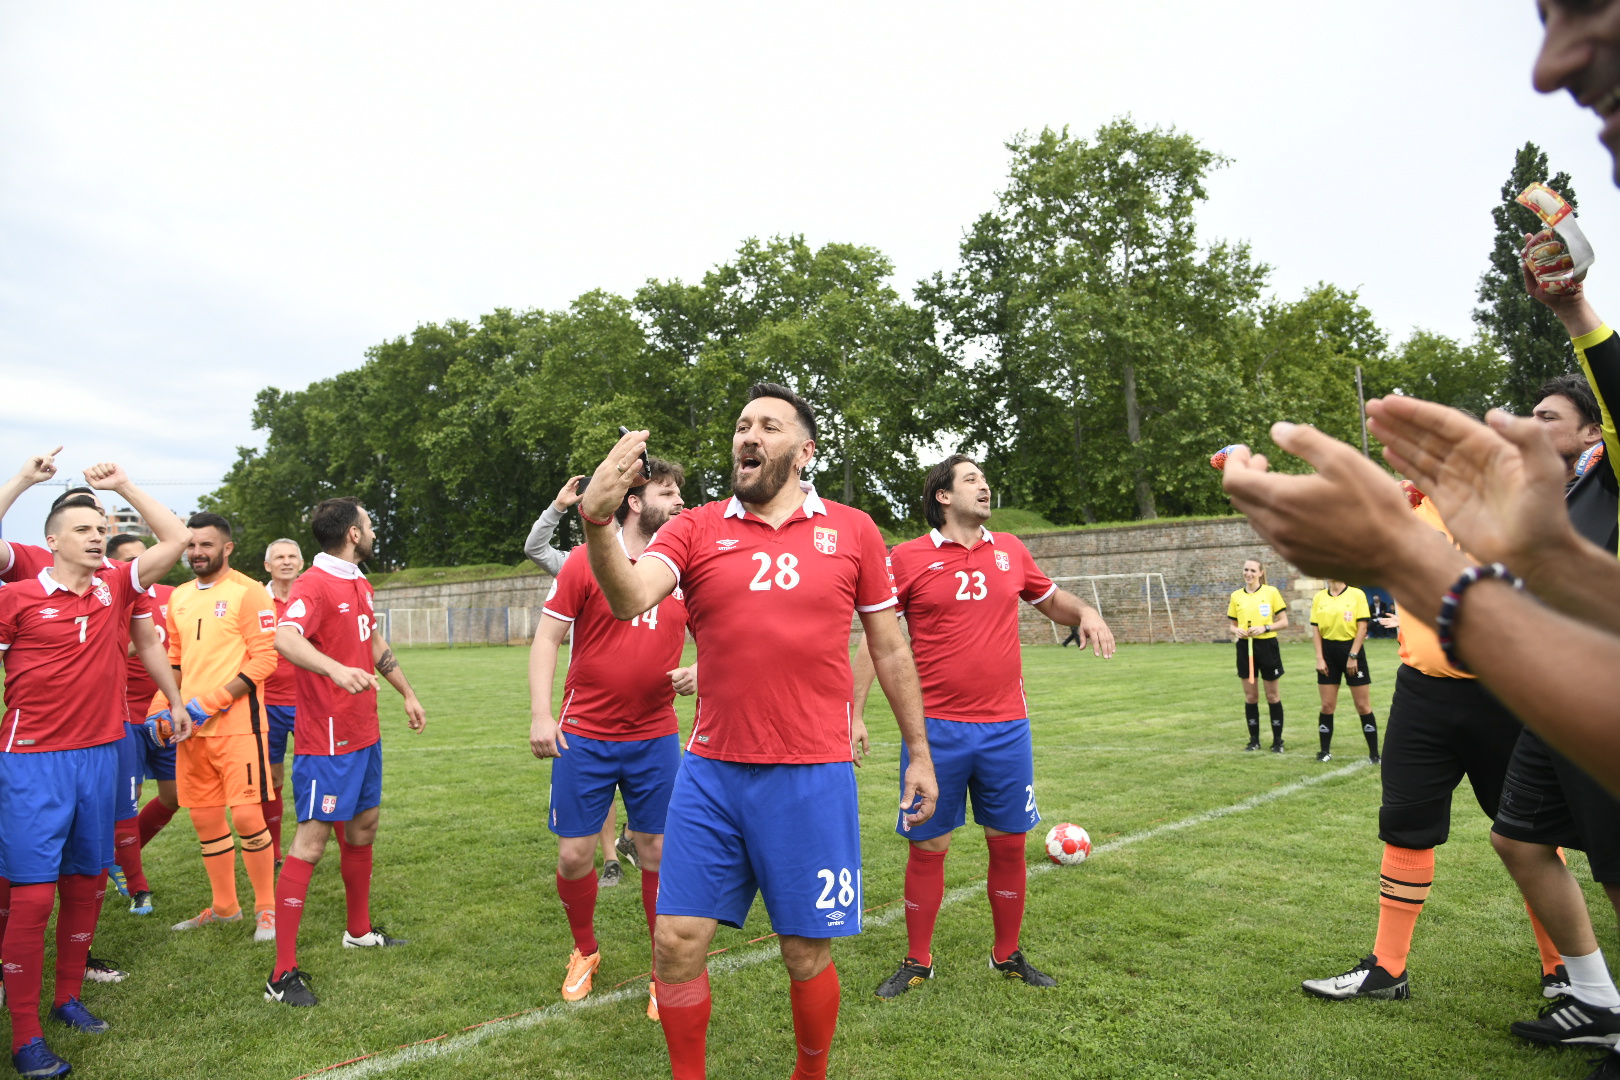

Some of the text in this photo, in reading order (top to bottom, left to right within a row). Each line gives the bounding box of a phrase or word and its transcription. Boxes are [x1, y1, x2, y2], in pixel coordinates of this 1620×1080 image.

[749, 551, 800, 591] 28
[954, 570, 988, 601] 23
[74, 615, 90, 644] 7
[196, 618, 202, 641] 1
[246, 762, 253, 786] 1
[815, 867, 855, 909] 28
